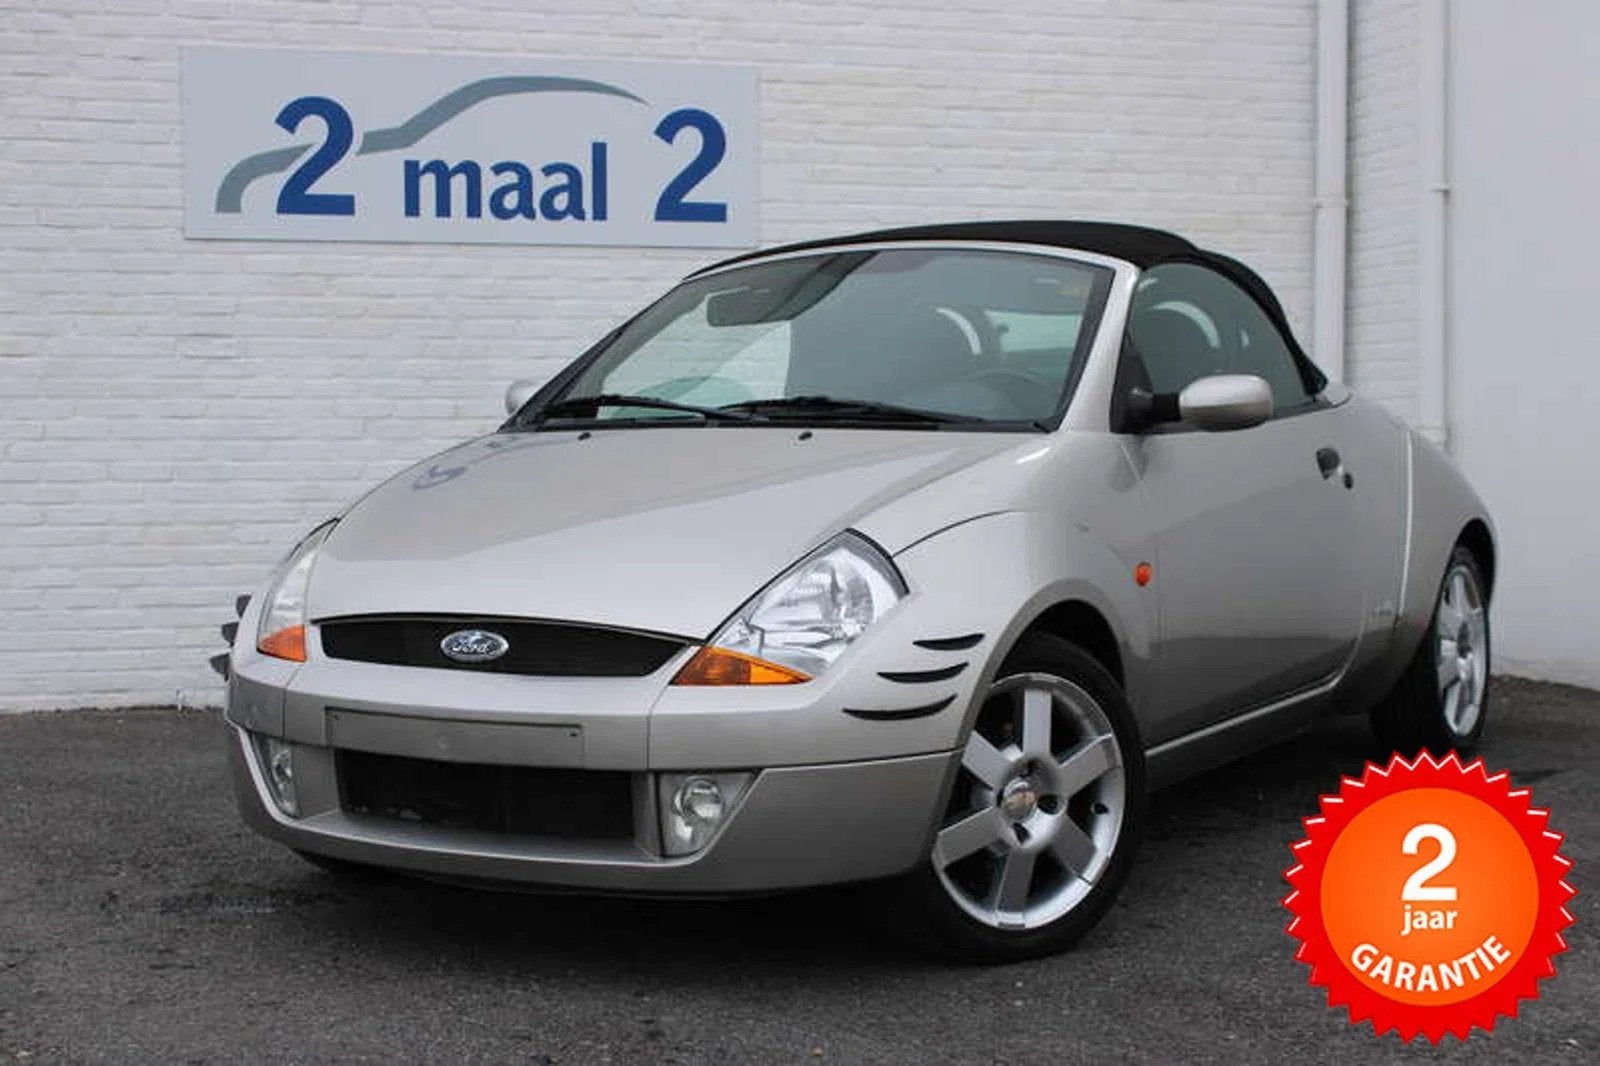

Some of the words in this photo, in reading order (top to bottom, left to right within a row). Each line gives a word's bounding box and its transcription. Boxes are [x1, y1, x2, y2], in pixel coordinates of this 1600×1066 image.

[275, 95, 355, 216] 2
[403, 140, 608, 221] maal
[654, 107, 729, 223] 2
[448, 634, 499, 655] Ford
